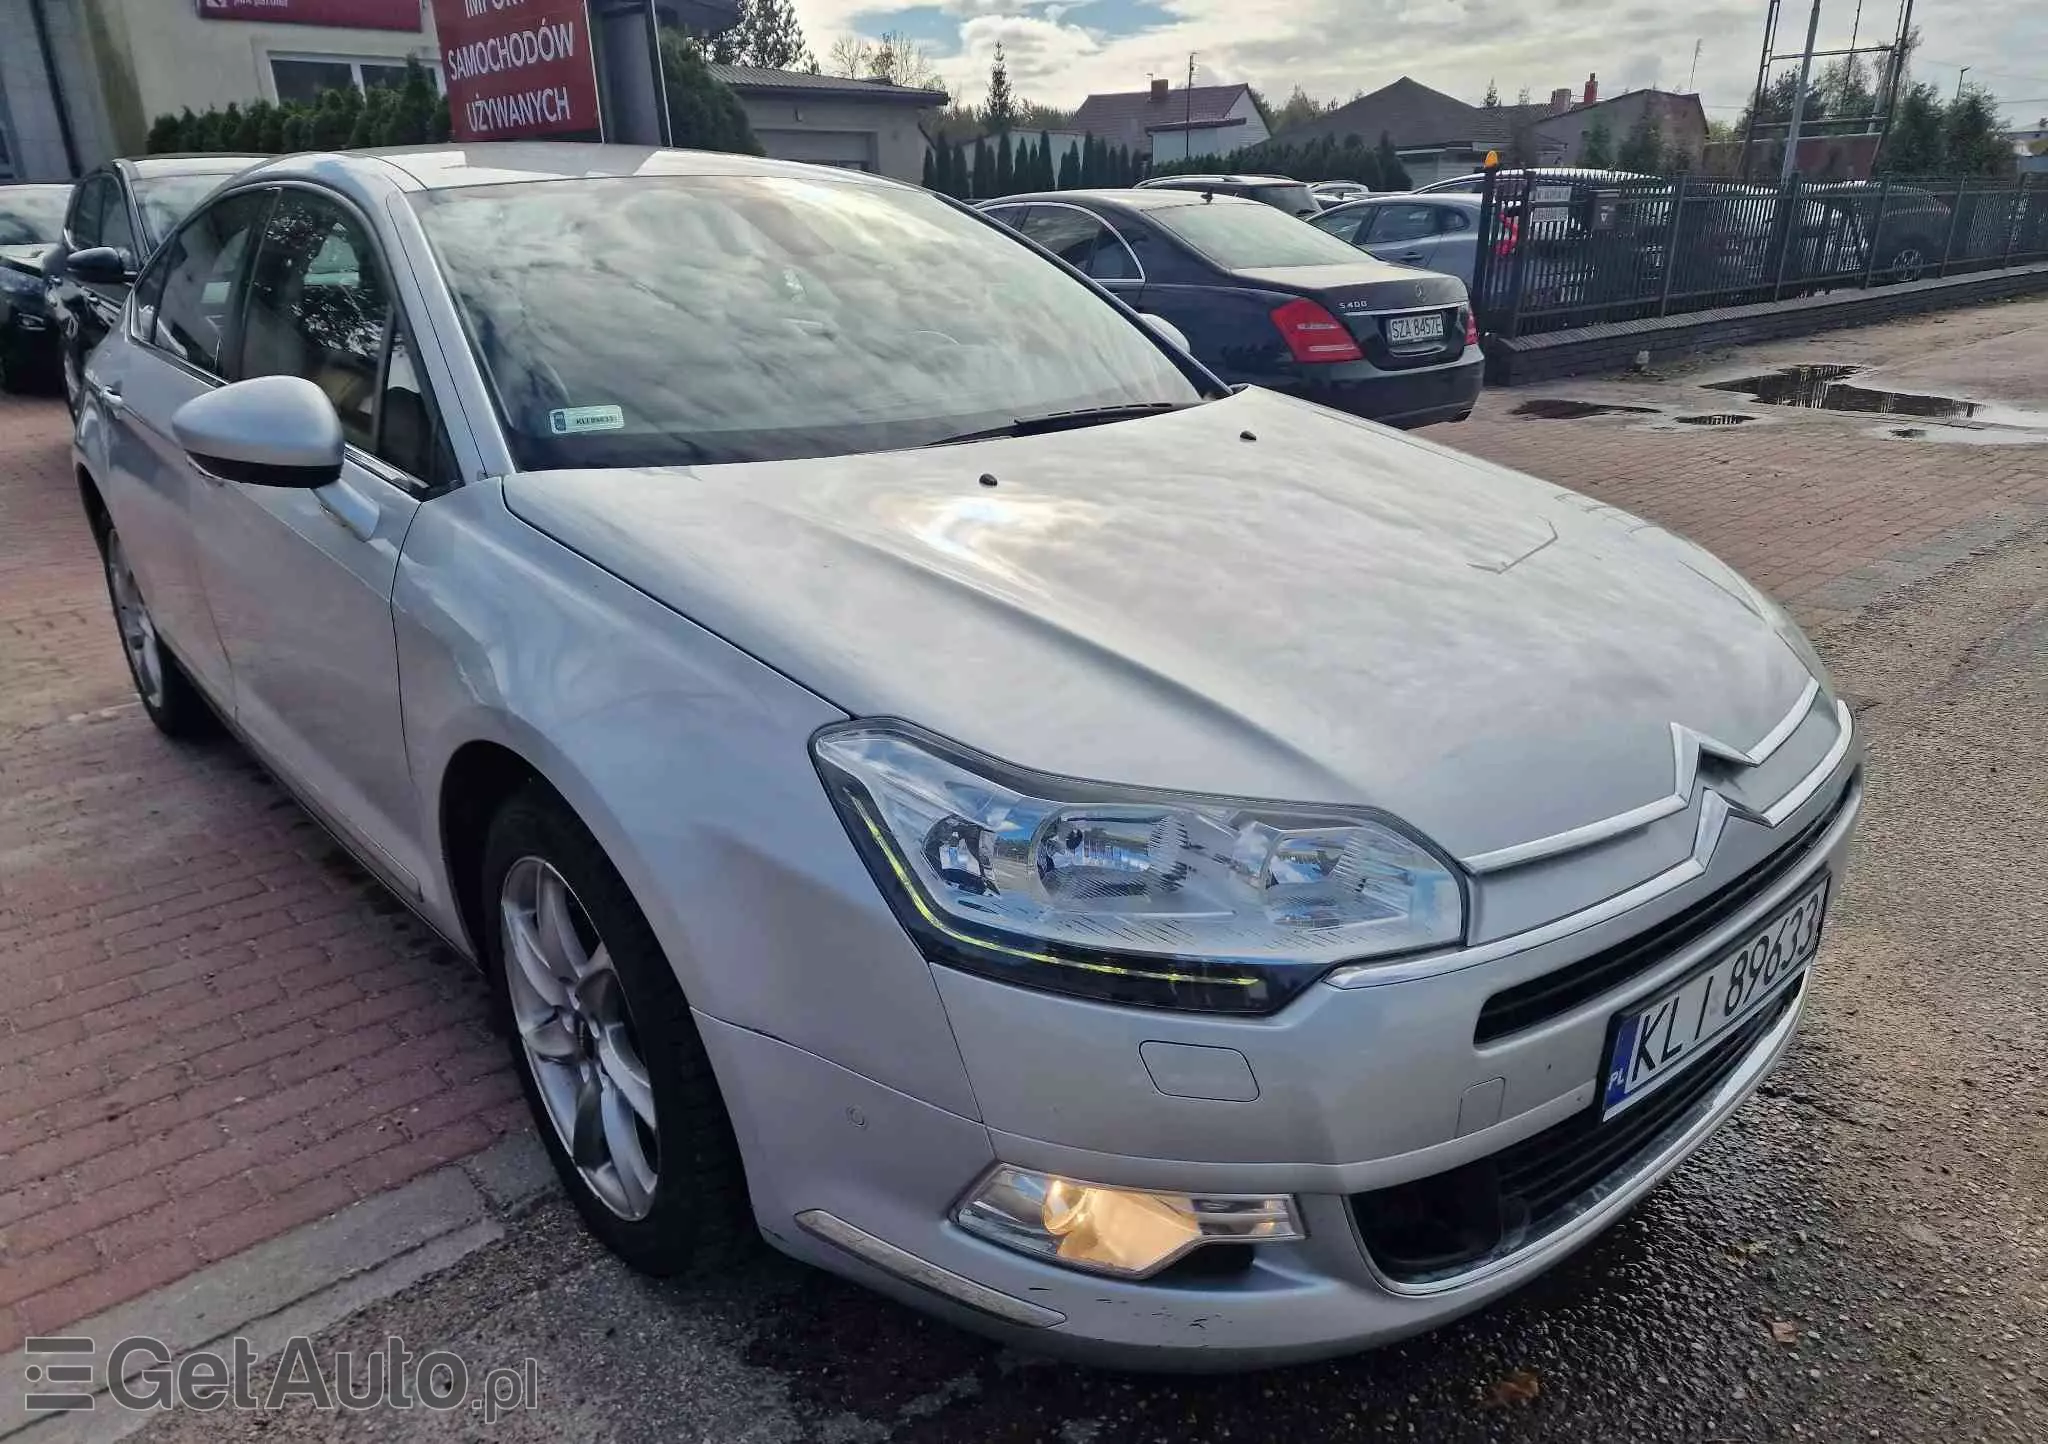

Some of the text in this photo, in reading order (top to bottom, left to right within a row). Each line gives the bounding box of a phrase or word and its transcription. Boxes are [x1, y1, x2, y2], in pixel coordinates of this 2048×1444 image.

[448, 17, 574, 81] SAMOCHODÓW
[466, 86, 571, 133] UŻYWANYCH
[1391, 318, 1412, 339] SZA
[1725, 894, 1819, 1017] 89633
[1608, 1068, 1624, 1091] PL
